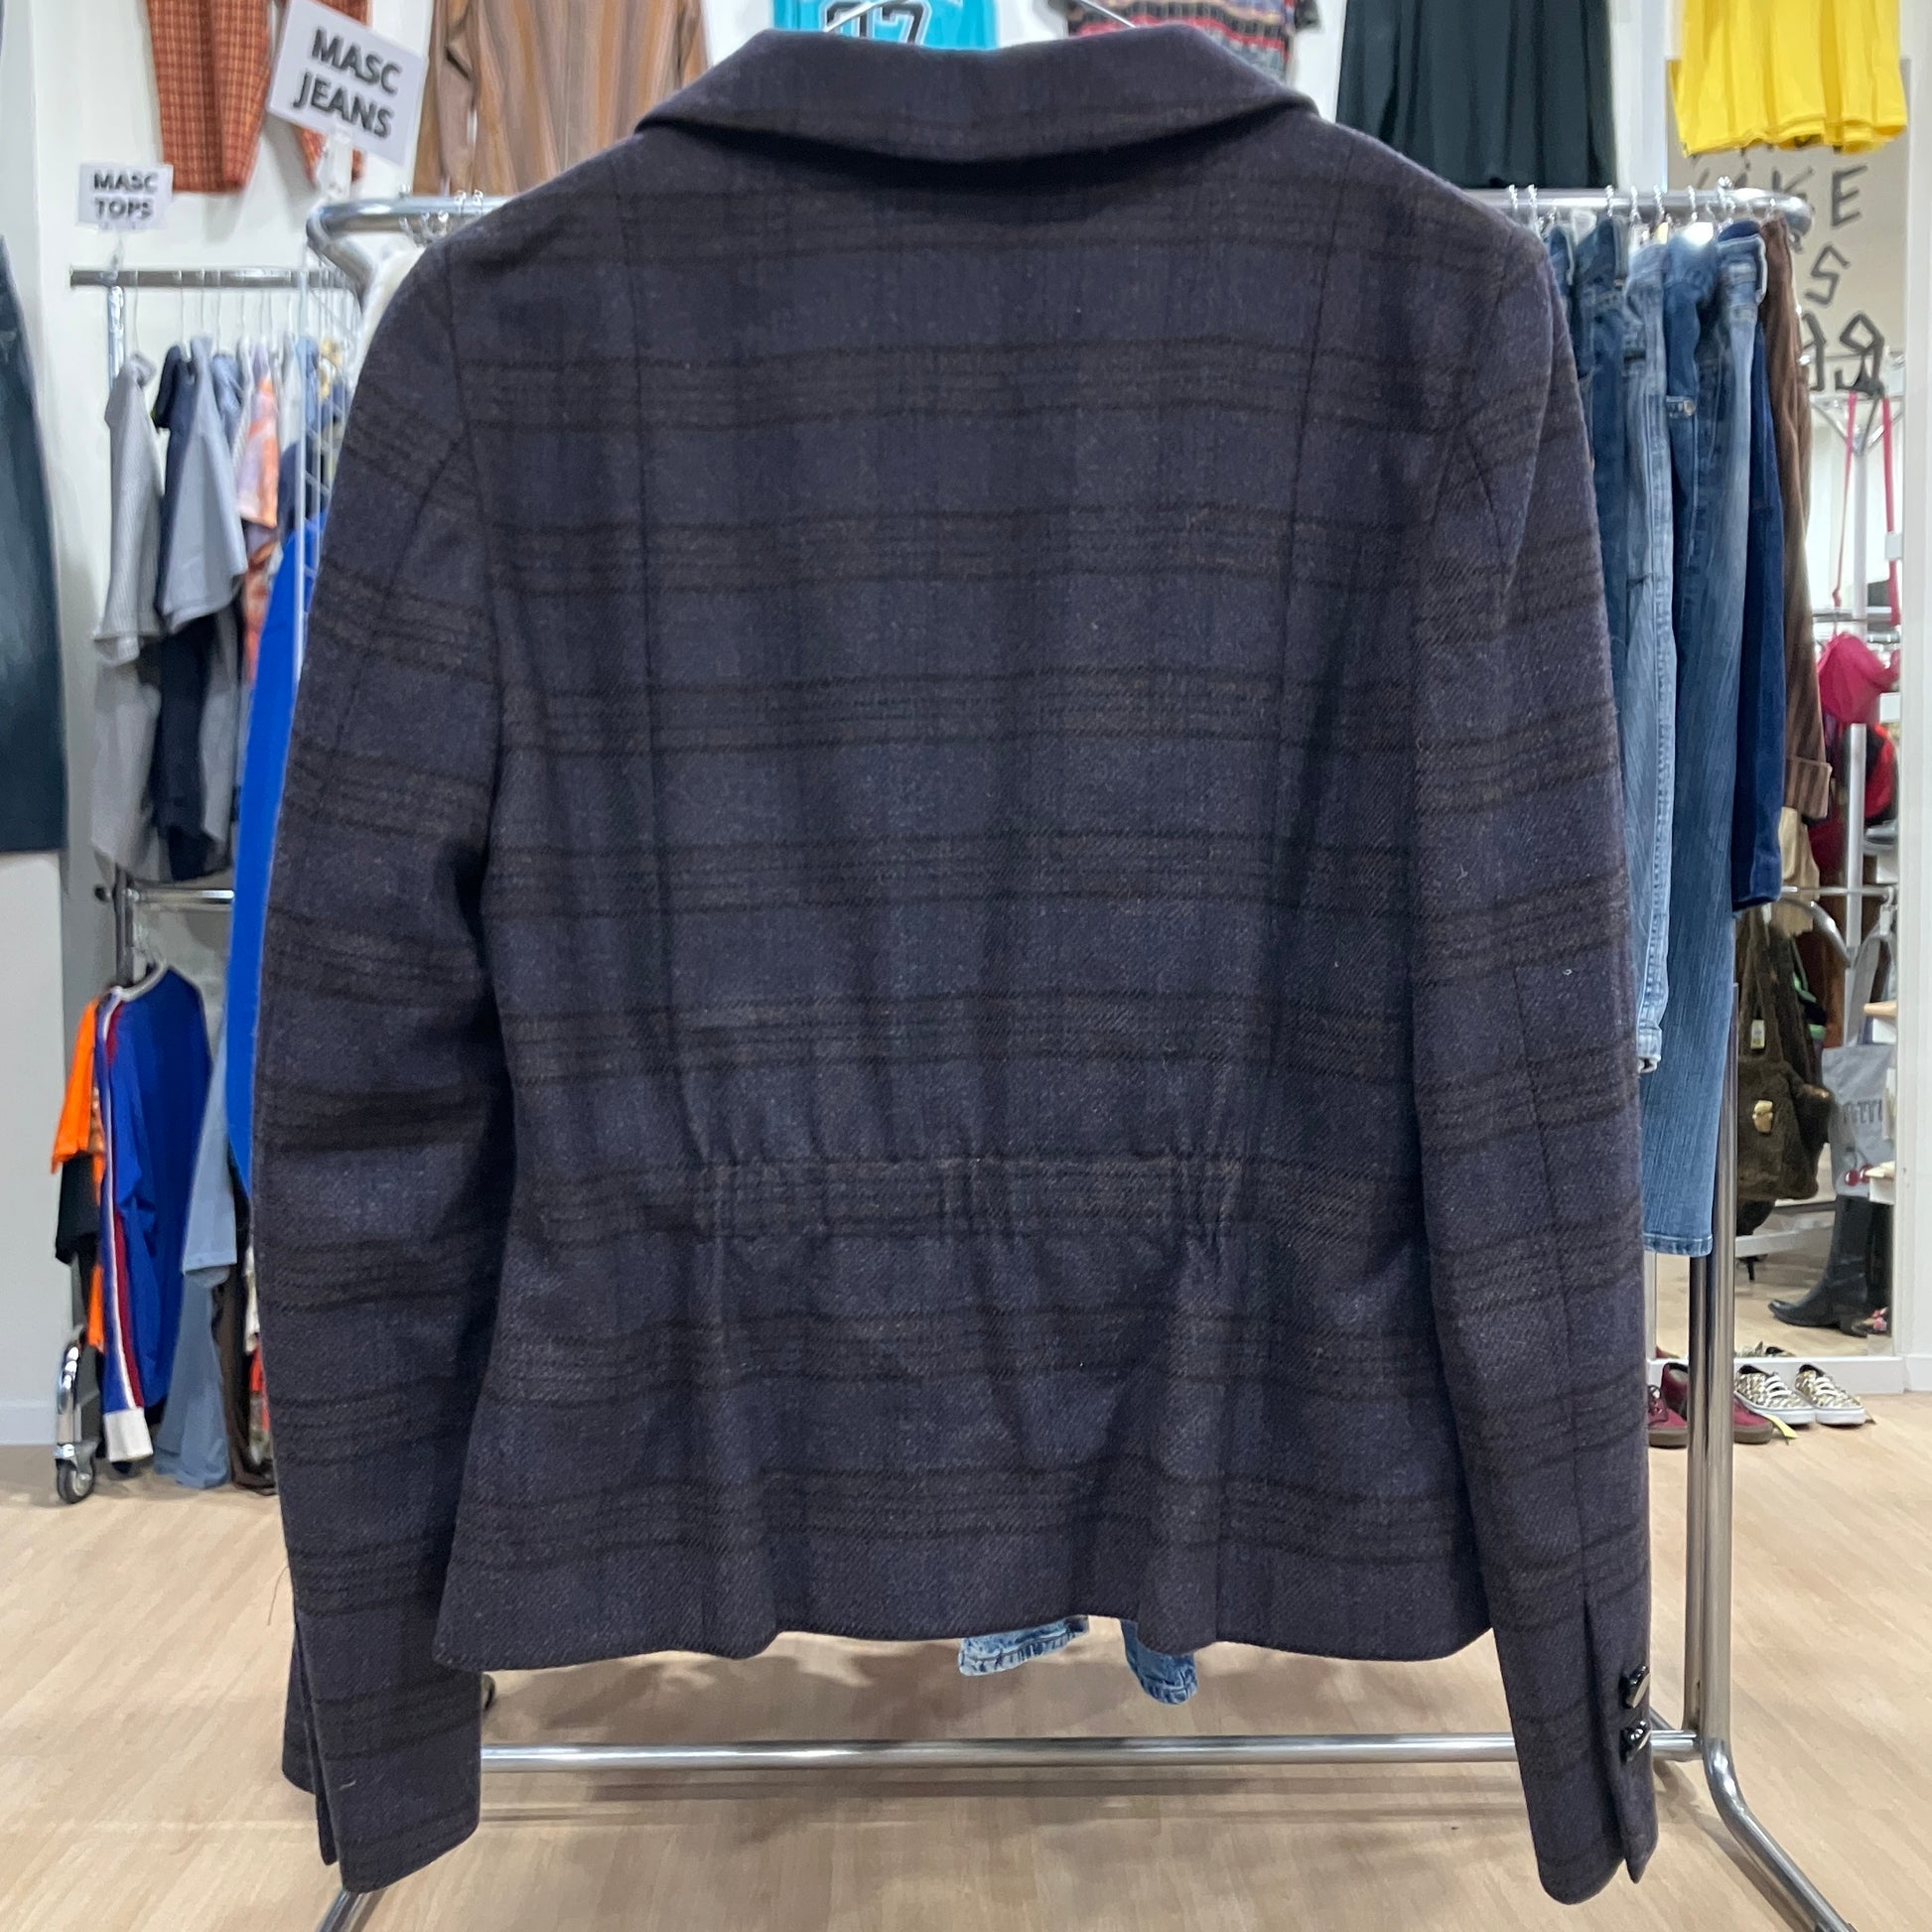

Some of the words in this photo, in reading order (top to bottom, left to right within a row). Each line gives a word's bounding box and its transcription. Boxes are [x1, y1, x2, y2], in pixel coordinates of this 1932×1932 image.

[310, 27, 401, 94] MASC
[292, 69, 394, 139] JEANS
[93, 171, 158, 192] MASC
[94, 198, 153, 219] TOPS
